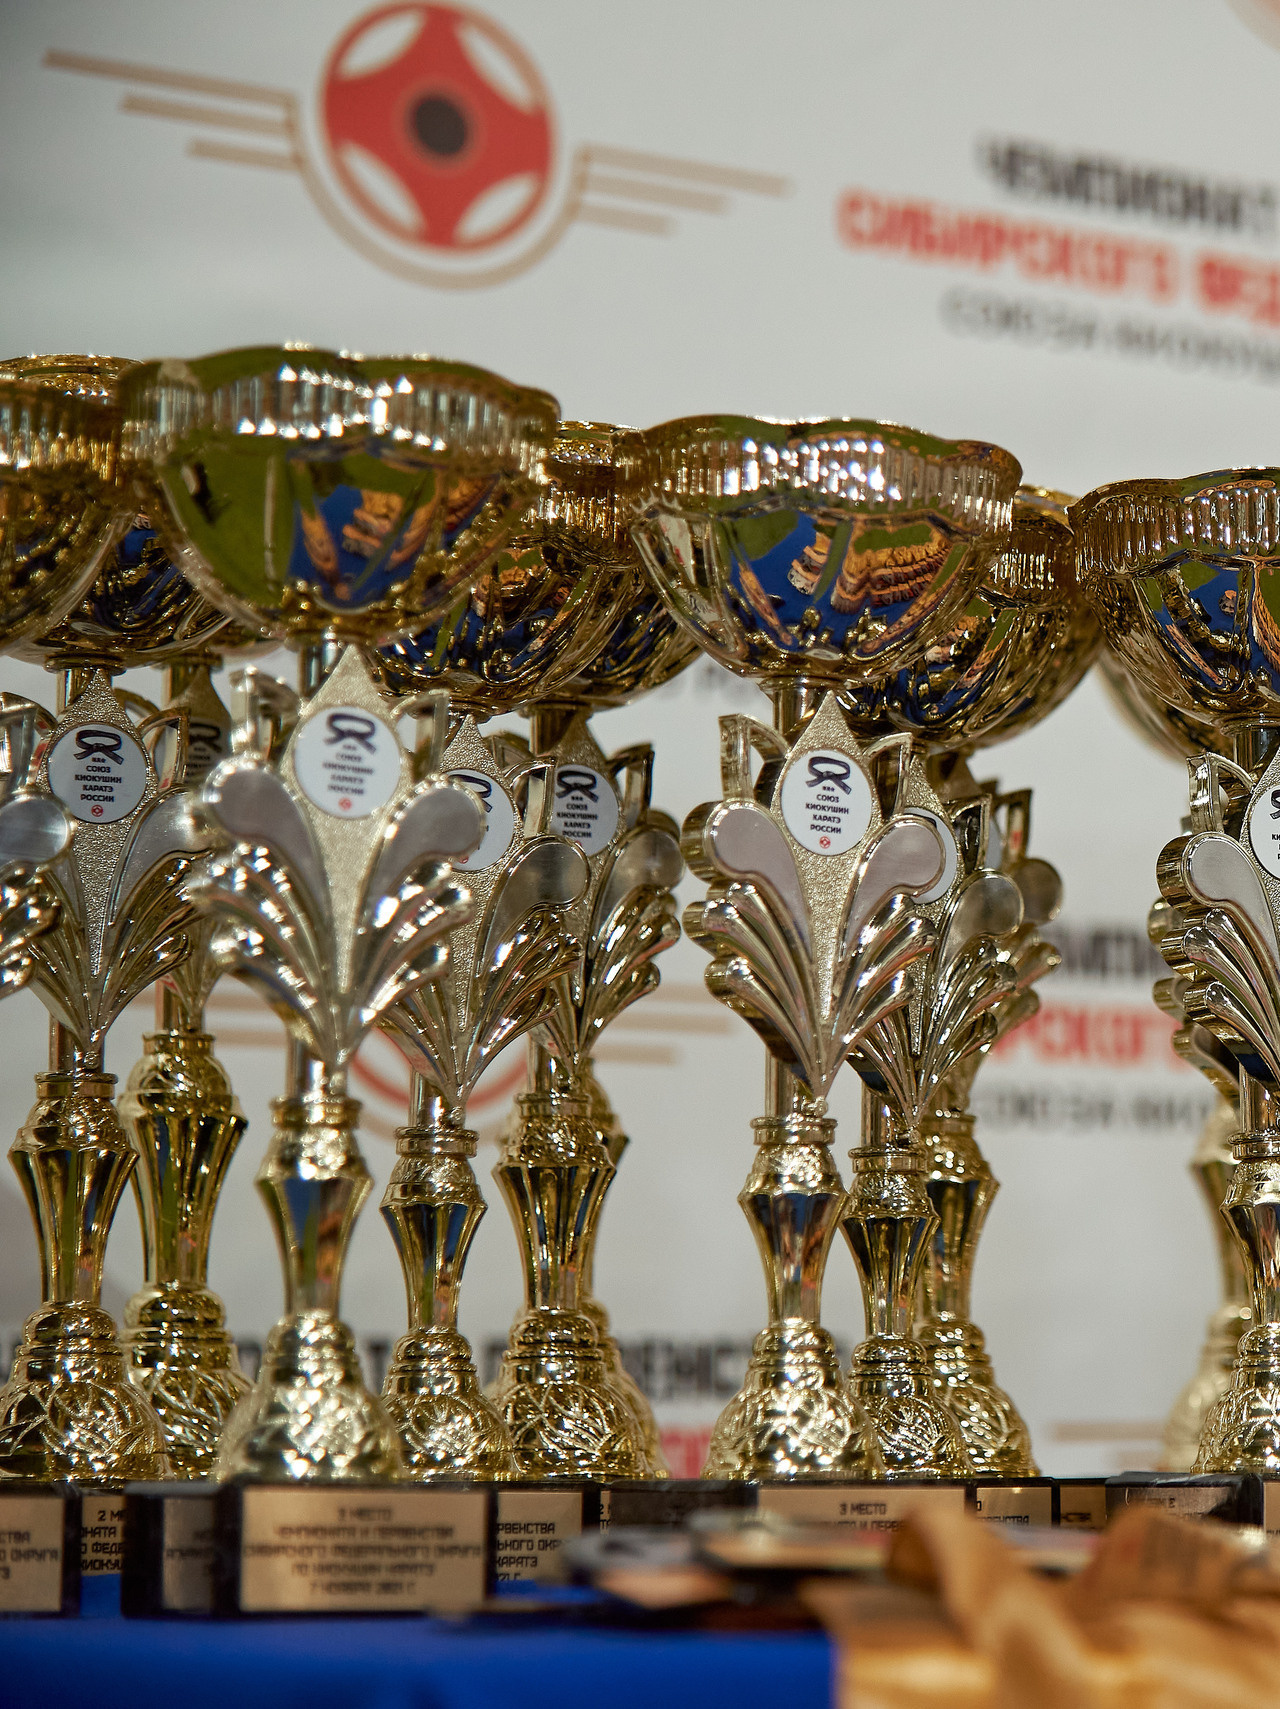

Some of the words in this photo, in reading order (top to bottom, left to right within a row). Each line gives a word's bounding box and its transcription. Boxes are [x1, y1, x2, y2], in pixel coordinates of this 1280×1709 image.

[836, 188, 1178, 304] СИБИРСКОГО
[86, 765, 111, 773] СОЮЗ
[74, 774, 122, 783] КИОКУШИН
[80, 794, 115, 802] РОССИИ
[816, 794, 840, 803] СОЮЗ
[805, 802, 850, 815] КИОКУШИН
[812, 814, 842, 824] КАРАТЭ
[810, 824, 842, 834] РОССИИ
[850, 1503, 887, 1515] МЕСТО
